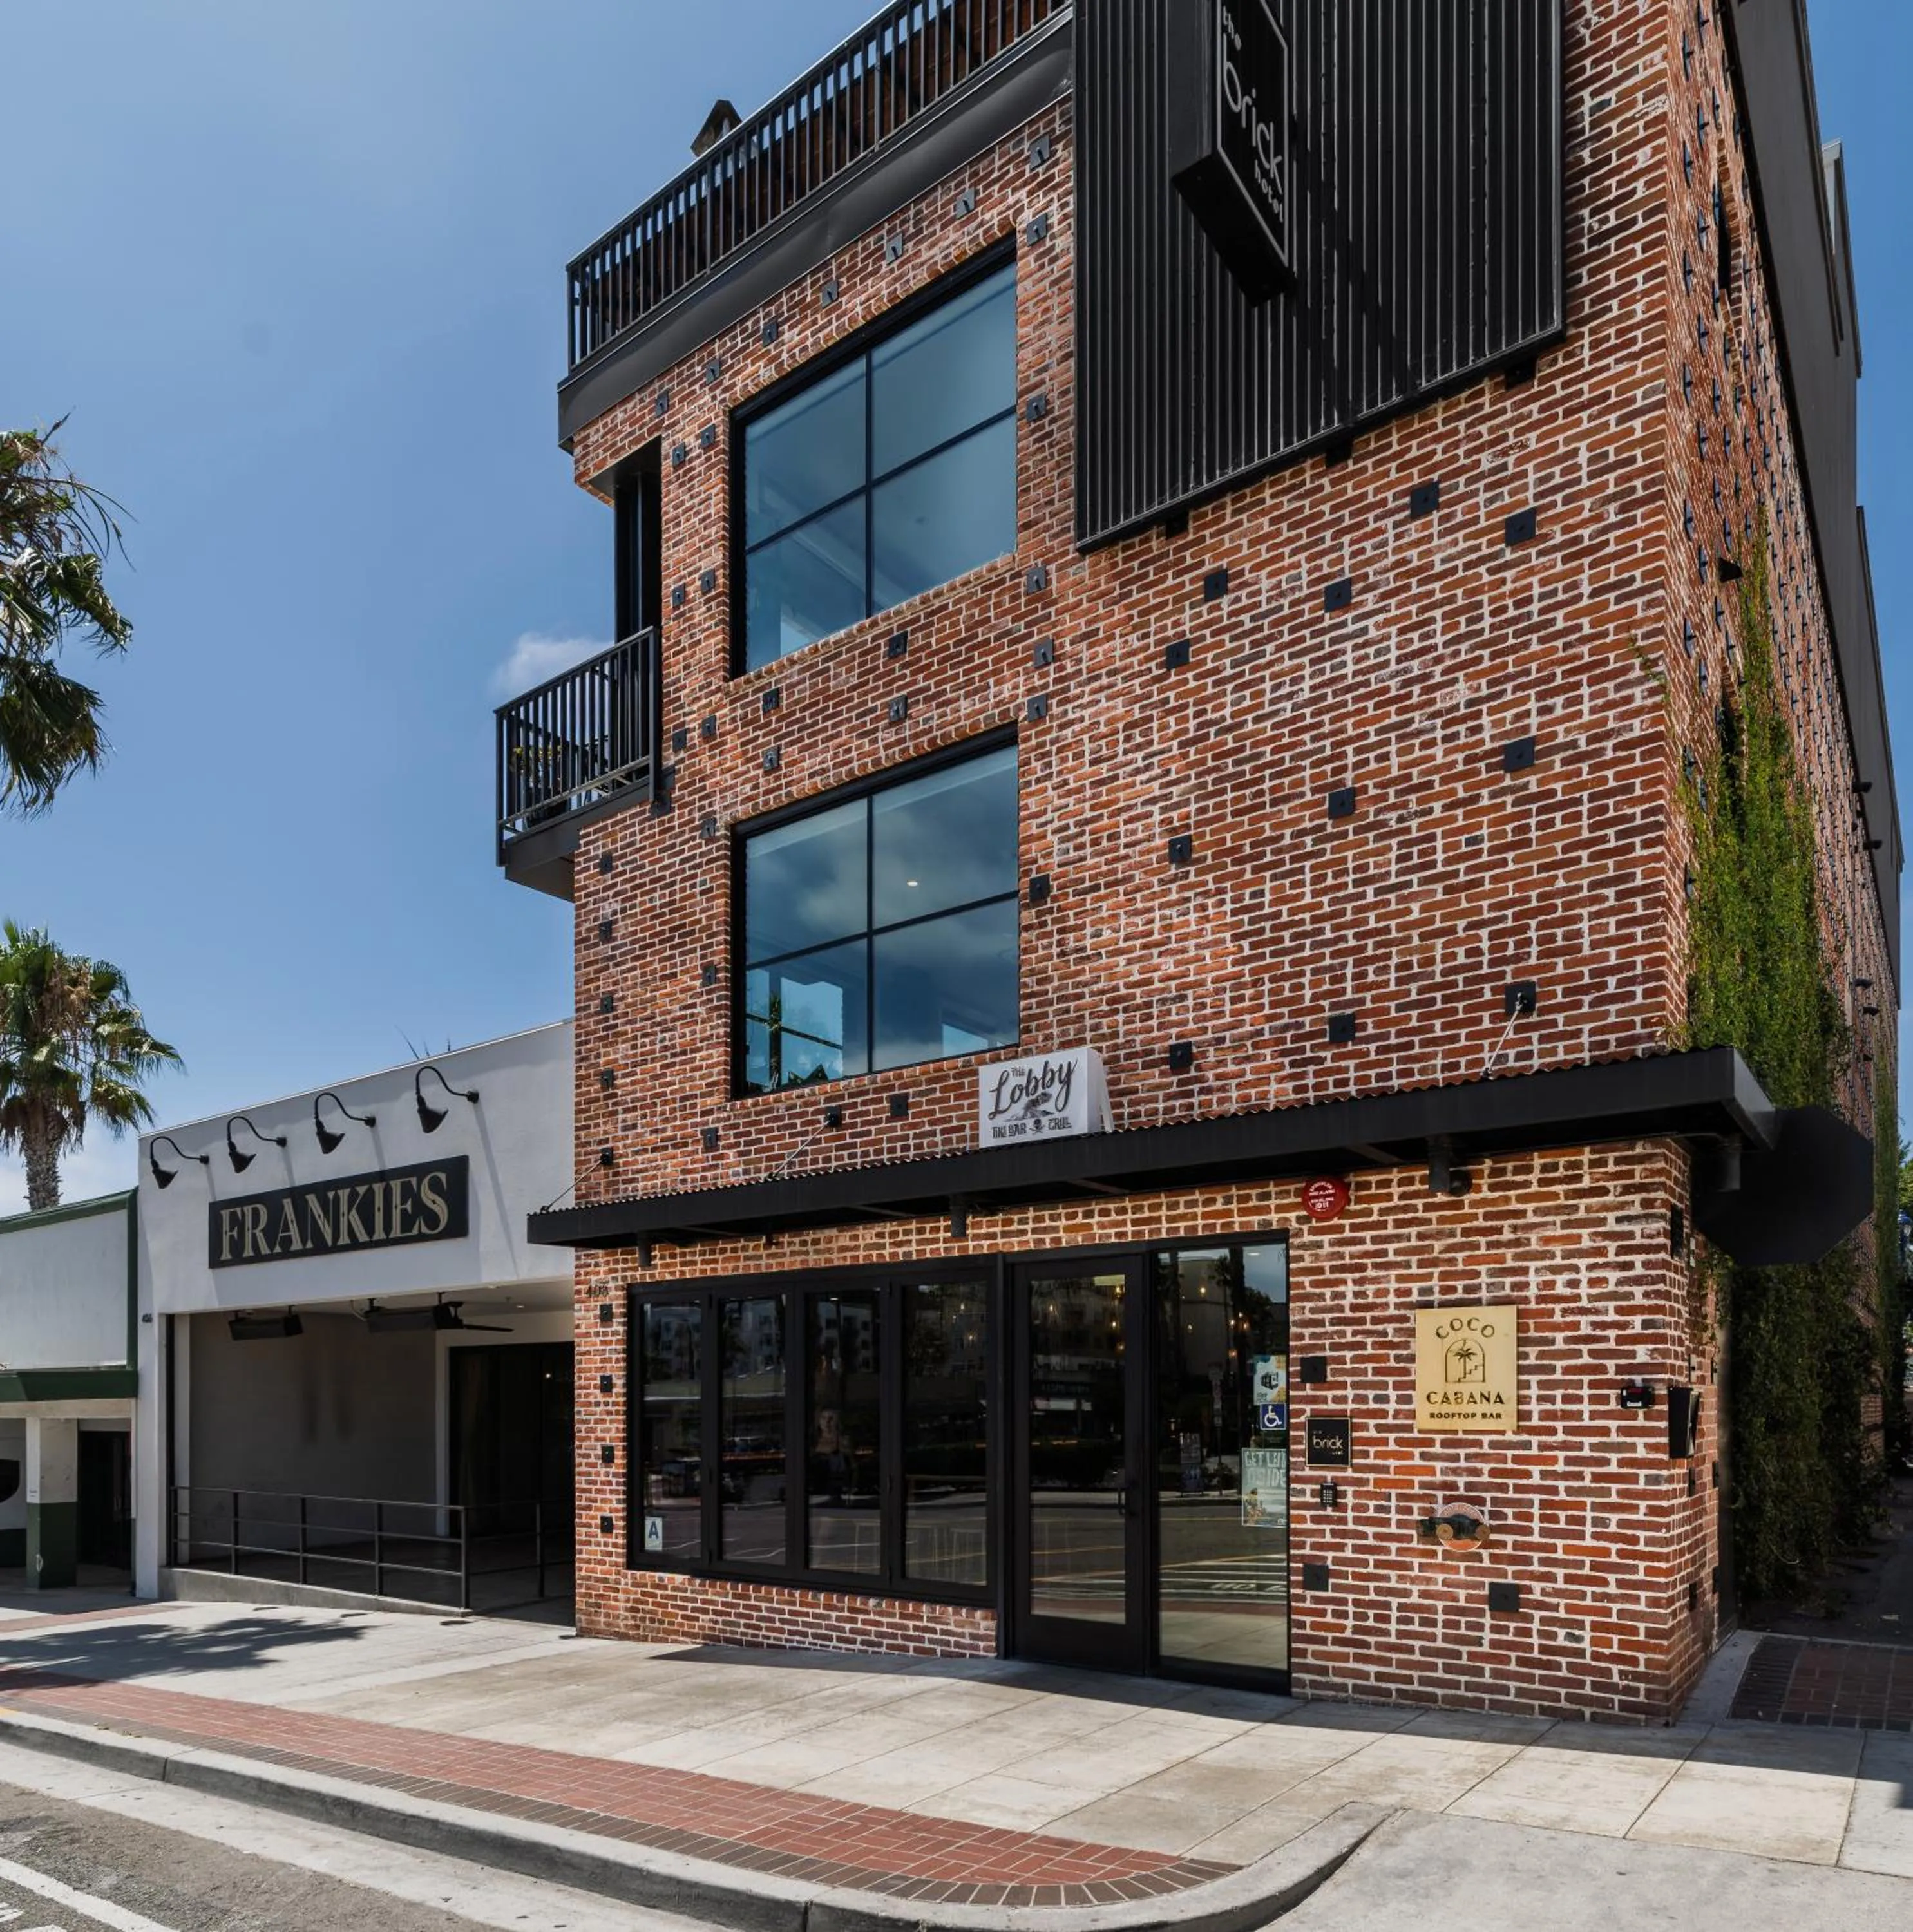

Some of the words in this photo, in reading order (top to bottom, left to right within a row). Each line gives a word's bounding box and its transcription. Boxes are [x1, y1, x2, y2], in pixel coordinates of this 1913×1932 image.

[1223, 33, 1283, 194] brick
[987, 1057, 1079, 1121] Lobby
[1008, 1123, 1027, 1137] BAR
[219, 1171, 450, 1261] FRANKIES
[1436, 1317, 1495, 1339] COCO
[1426, 1390, 1505, 1405] CABANA
[1313, 1435, 1343, 1449] brick
[649, 1520, 659, 1539] A
